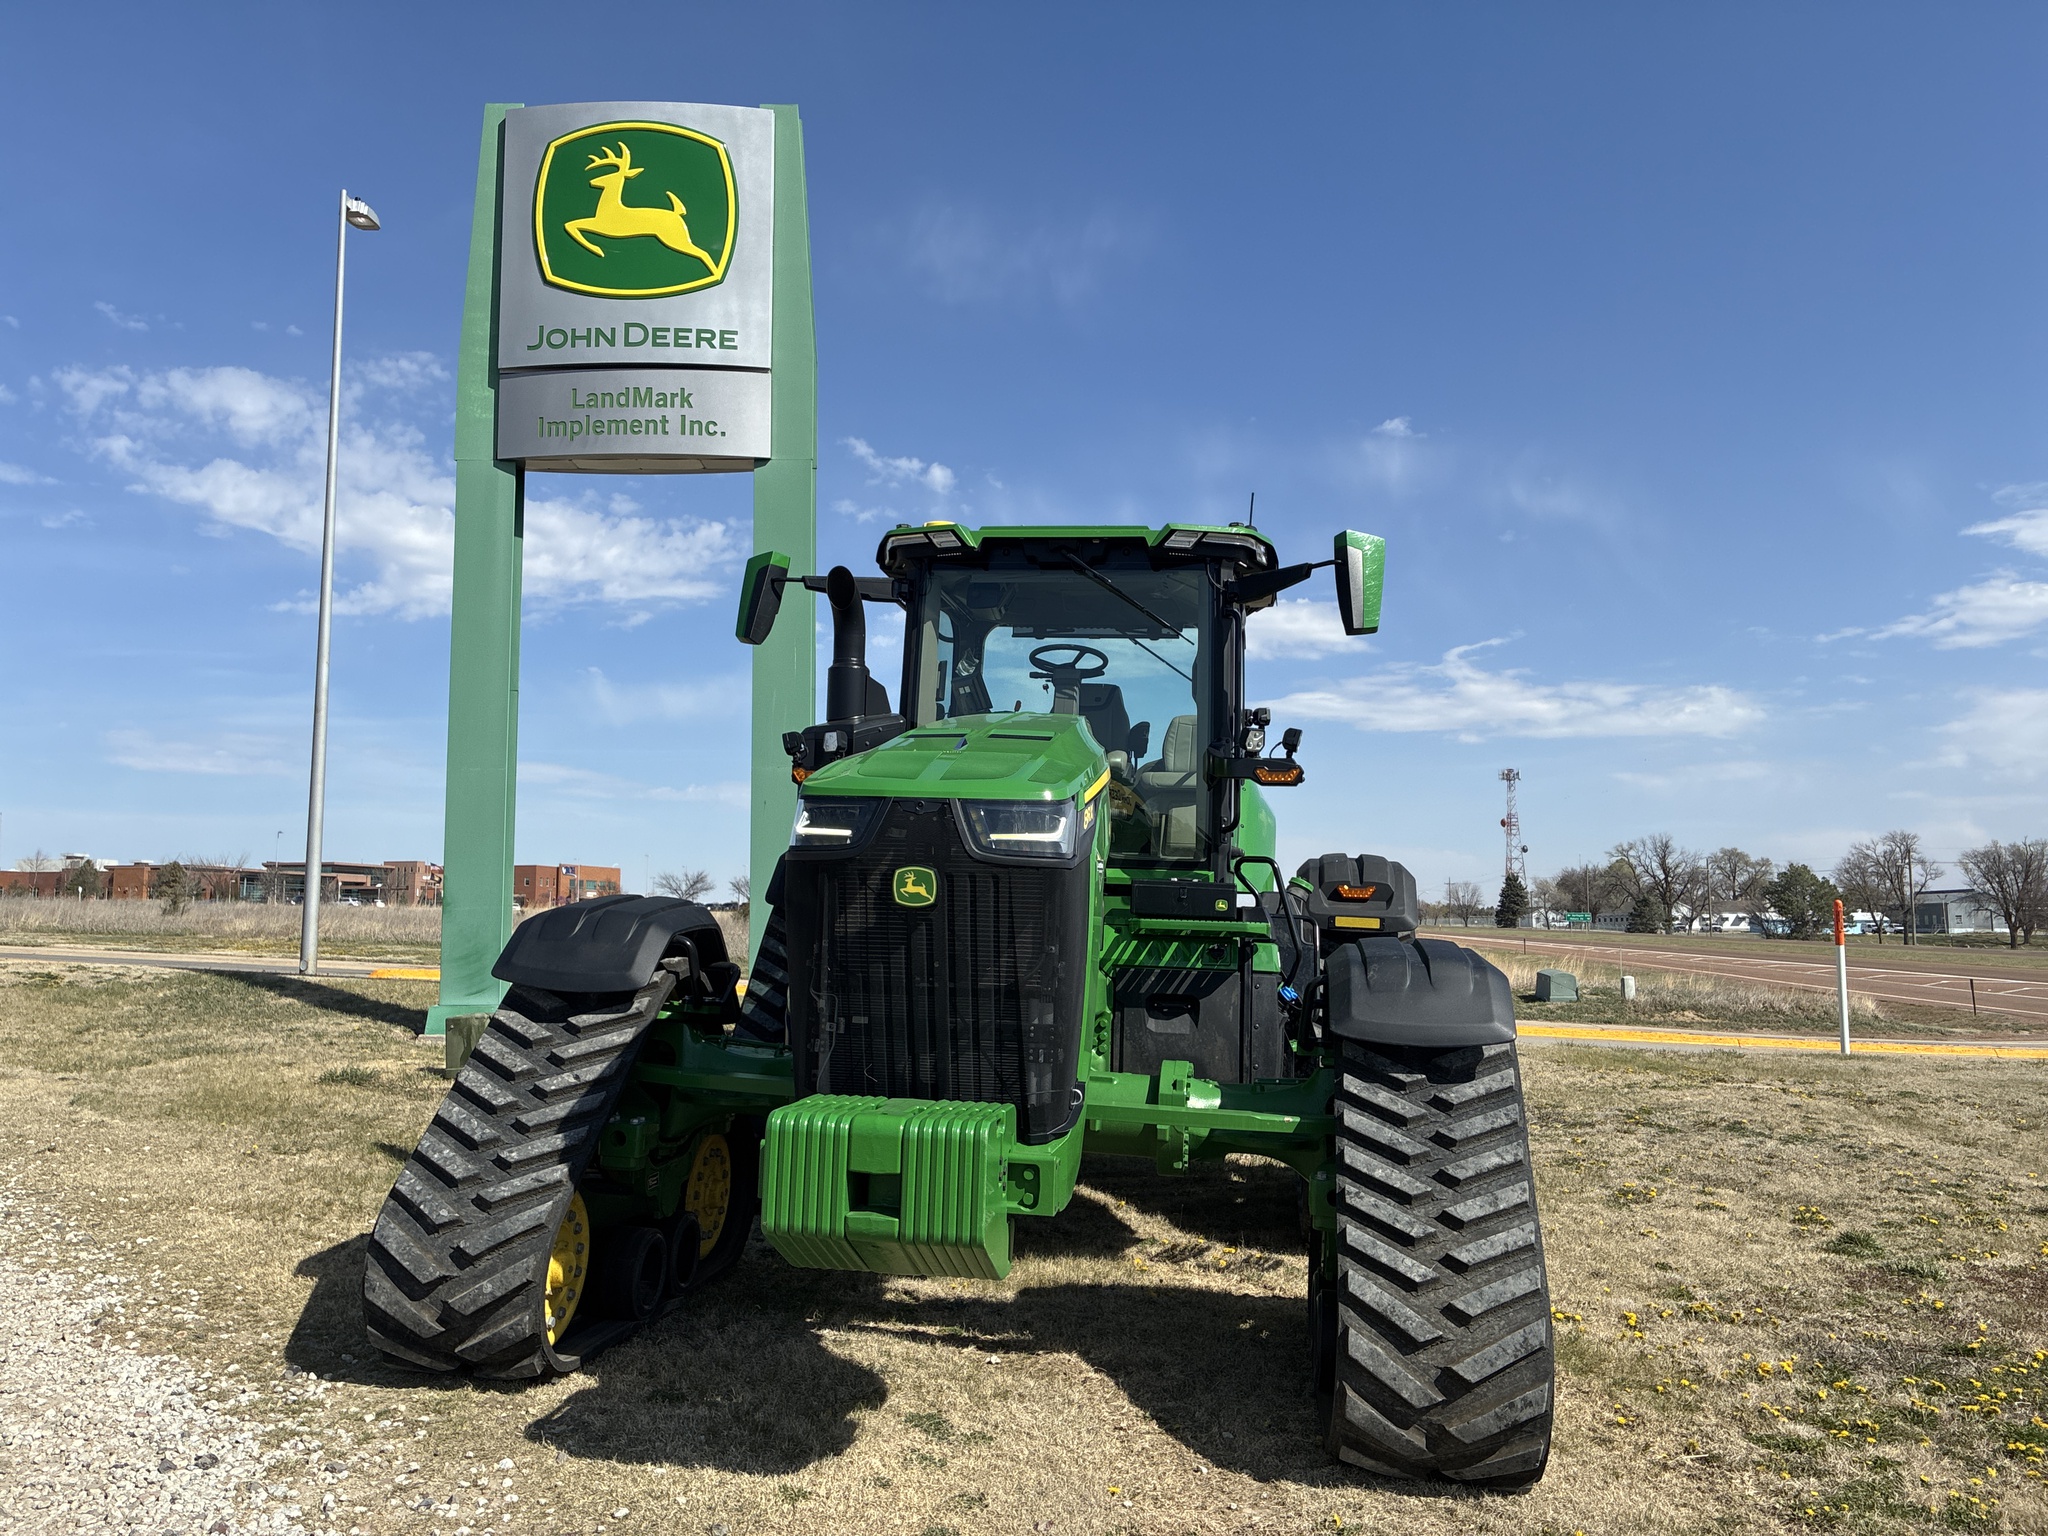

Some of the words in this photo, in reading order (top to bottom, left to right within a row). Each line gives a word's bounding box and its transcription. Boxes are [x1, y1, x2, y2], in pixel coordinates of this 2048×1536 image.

[527, 325, 616, 351] JOHN
[623, 322, 739, 350] DEERE
[571, 387, 694, 409] LandMark
[538, 415, 669, 441] Implement
[680, 415, 727, 437] Inc.
